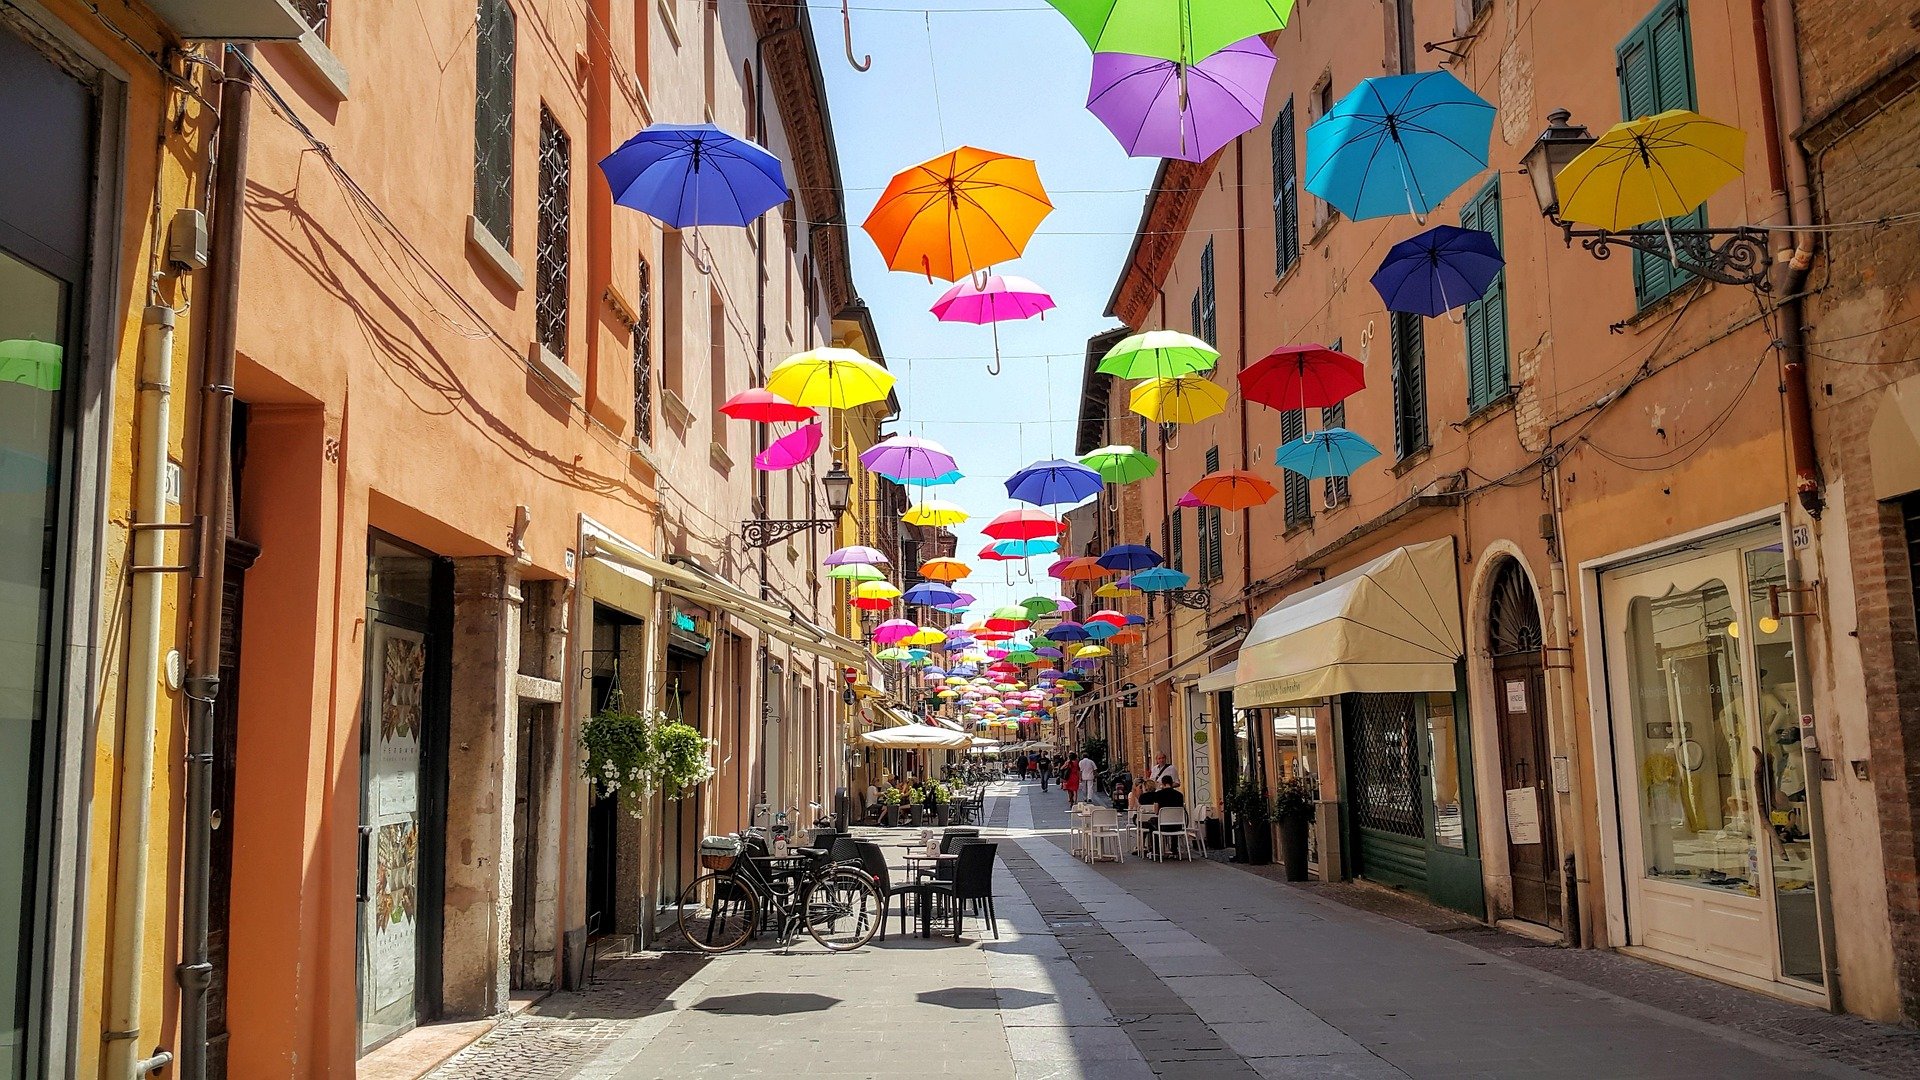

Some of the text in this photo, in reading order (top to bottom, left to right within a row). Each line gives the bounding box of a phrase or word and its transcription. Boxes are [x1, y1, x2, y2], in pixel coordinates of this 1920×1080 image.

[165, 465, 179, 498] 31
[1793, 527, 1809, 547] 38
[566, 552, 574, 568] 37
